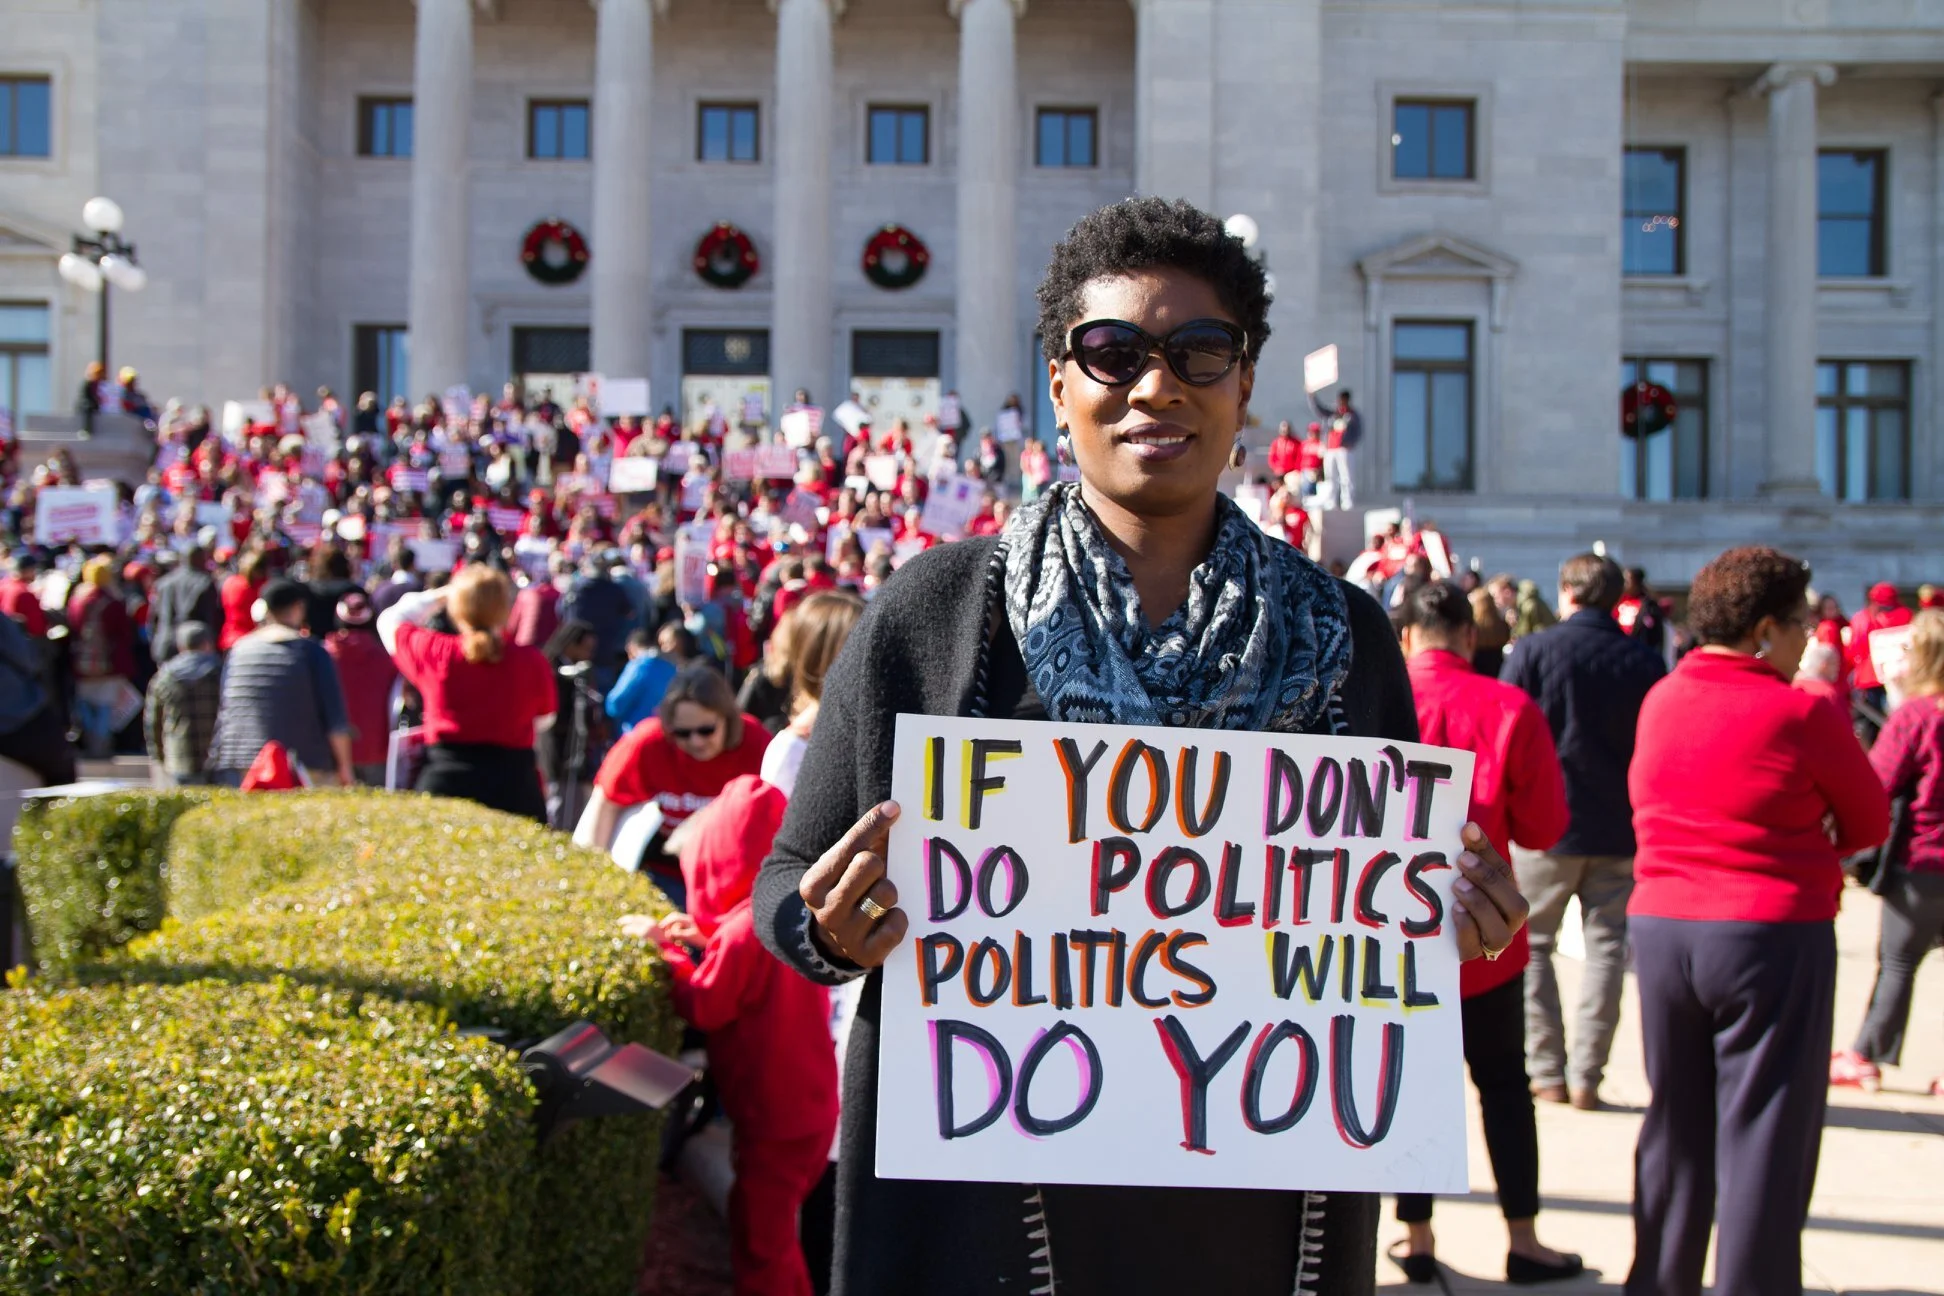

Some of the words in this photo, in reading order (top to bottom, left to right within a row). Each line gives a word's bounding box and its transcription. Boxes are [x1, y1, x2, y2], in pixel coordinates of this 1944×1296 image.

[923, 736, 1022, 829] IF
[1053, 737, 1231, 843] YOU
[1262, 744, 1453, 840] DON'T
[923, 836, 1029, 923] DO
[1090, 836, 1452, 938] POLITICS
[916, 927, 1217, 1009] POLITICS
[1266, 932, 1440, 1015] WILL
[927, 1019, 1103, 1140] DO
[1153, 1014, 1404, 1155] YOU
